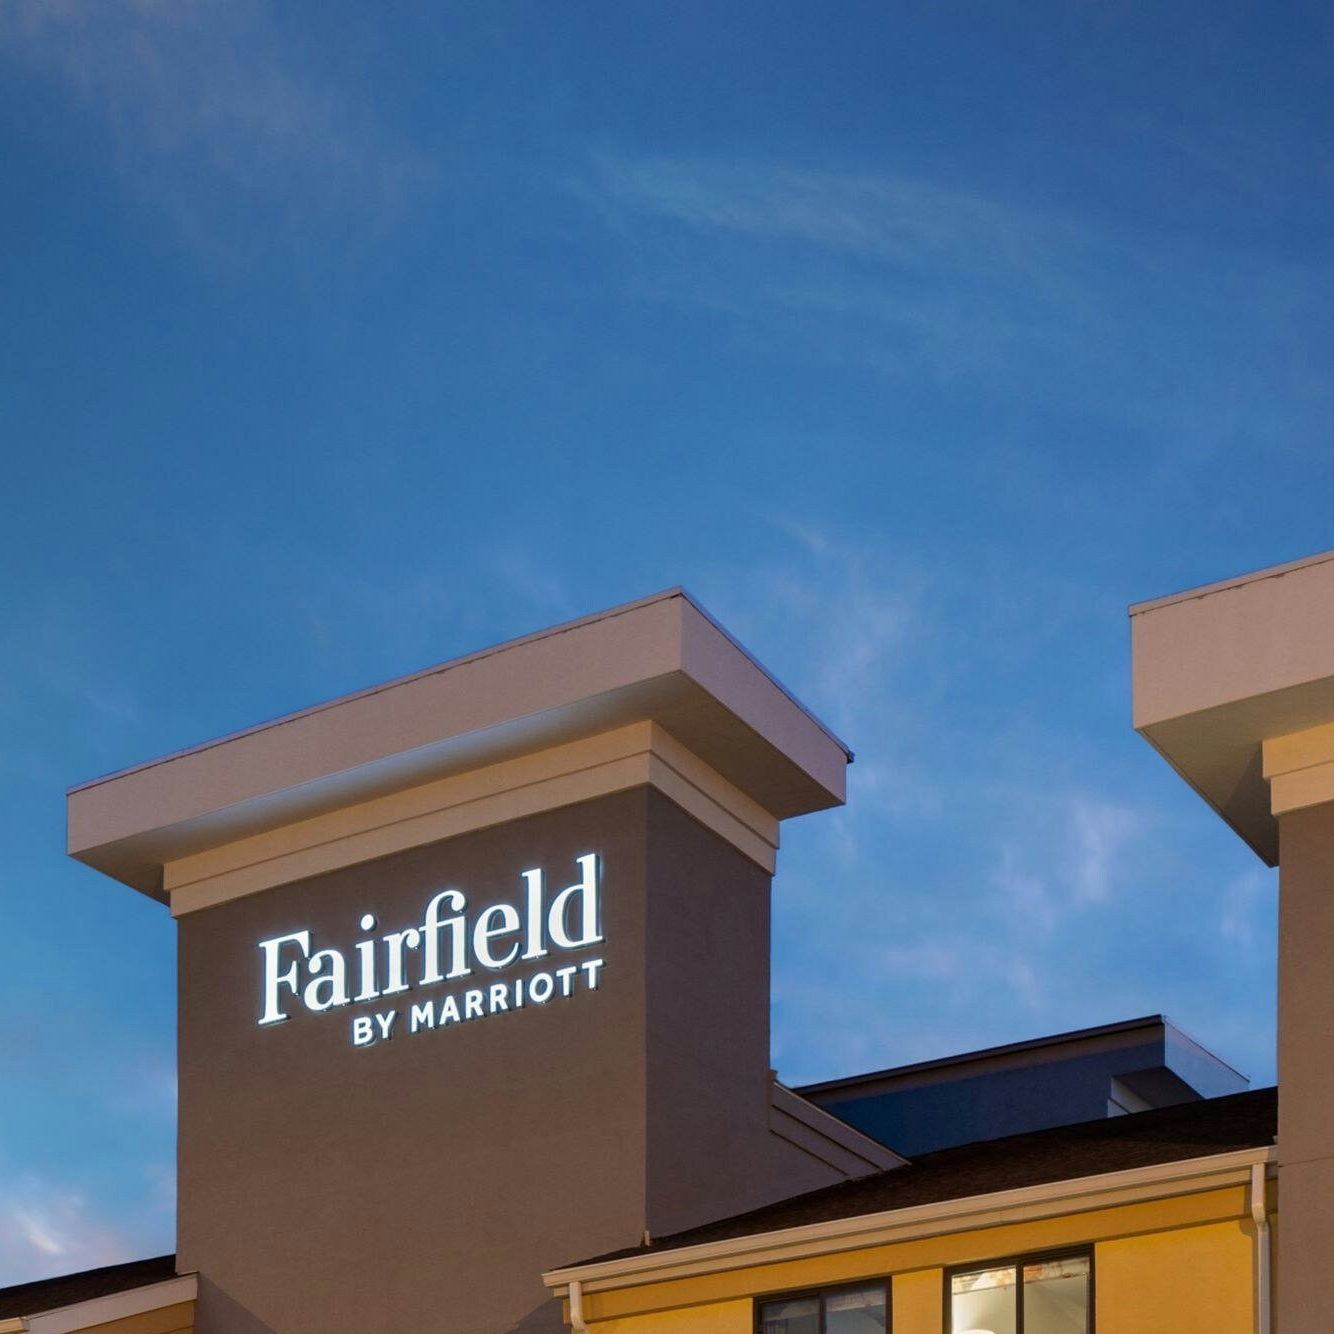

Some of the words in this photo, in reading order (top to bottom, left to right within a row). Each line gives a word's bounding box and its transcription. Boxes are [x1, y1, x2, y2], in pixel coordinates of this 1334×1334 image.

[257, 853, 604, 1026] Fairfield
[352, 1010, 397, 1046] BY
[410, 958, 604, 1034] MARRIOTT
